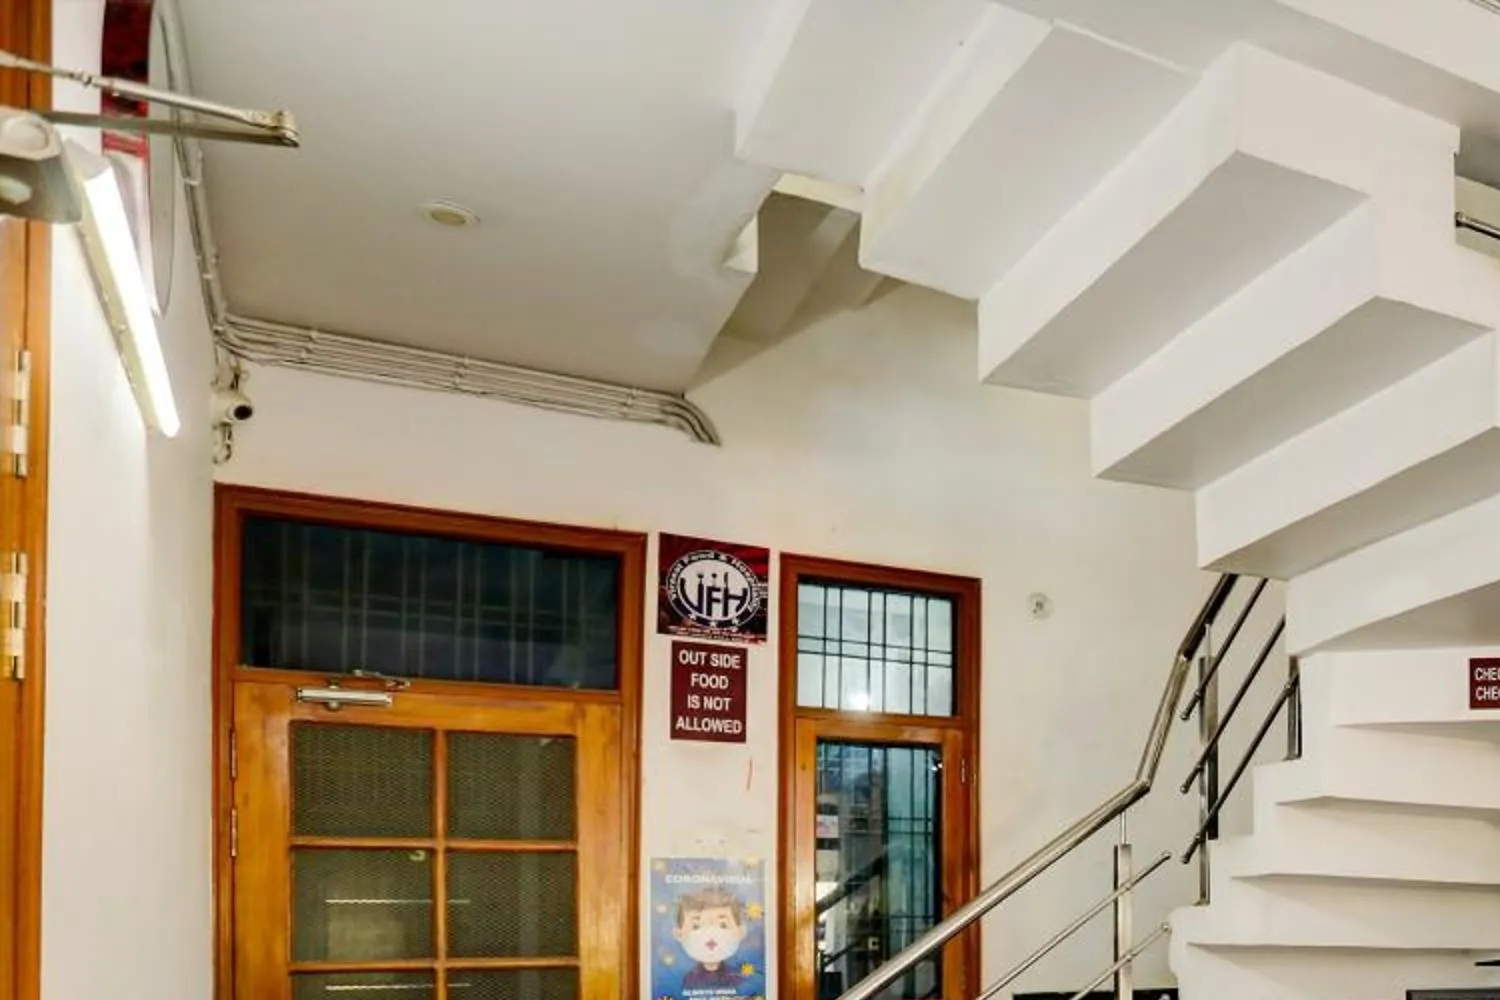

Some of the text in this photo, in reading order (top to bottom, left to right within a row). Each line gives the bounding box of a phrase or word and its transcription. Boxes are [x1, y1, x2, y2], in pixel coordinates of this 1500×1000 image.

[679, 649, 741, 669] OUT SIDE
[690, 672, 729, 689] FOOD
[687, 694, 732, 711] IS NOT
[675, 715, 743, 734] ALLOWED
